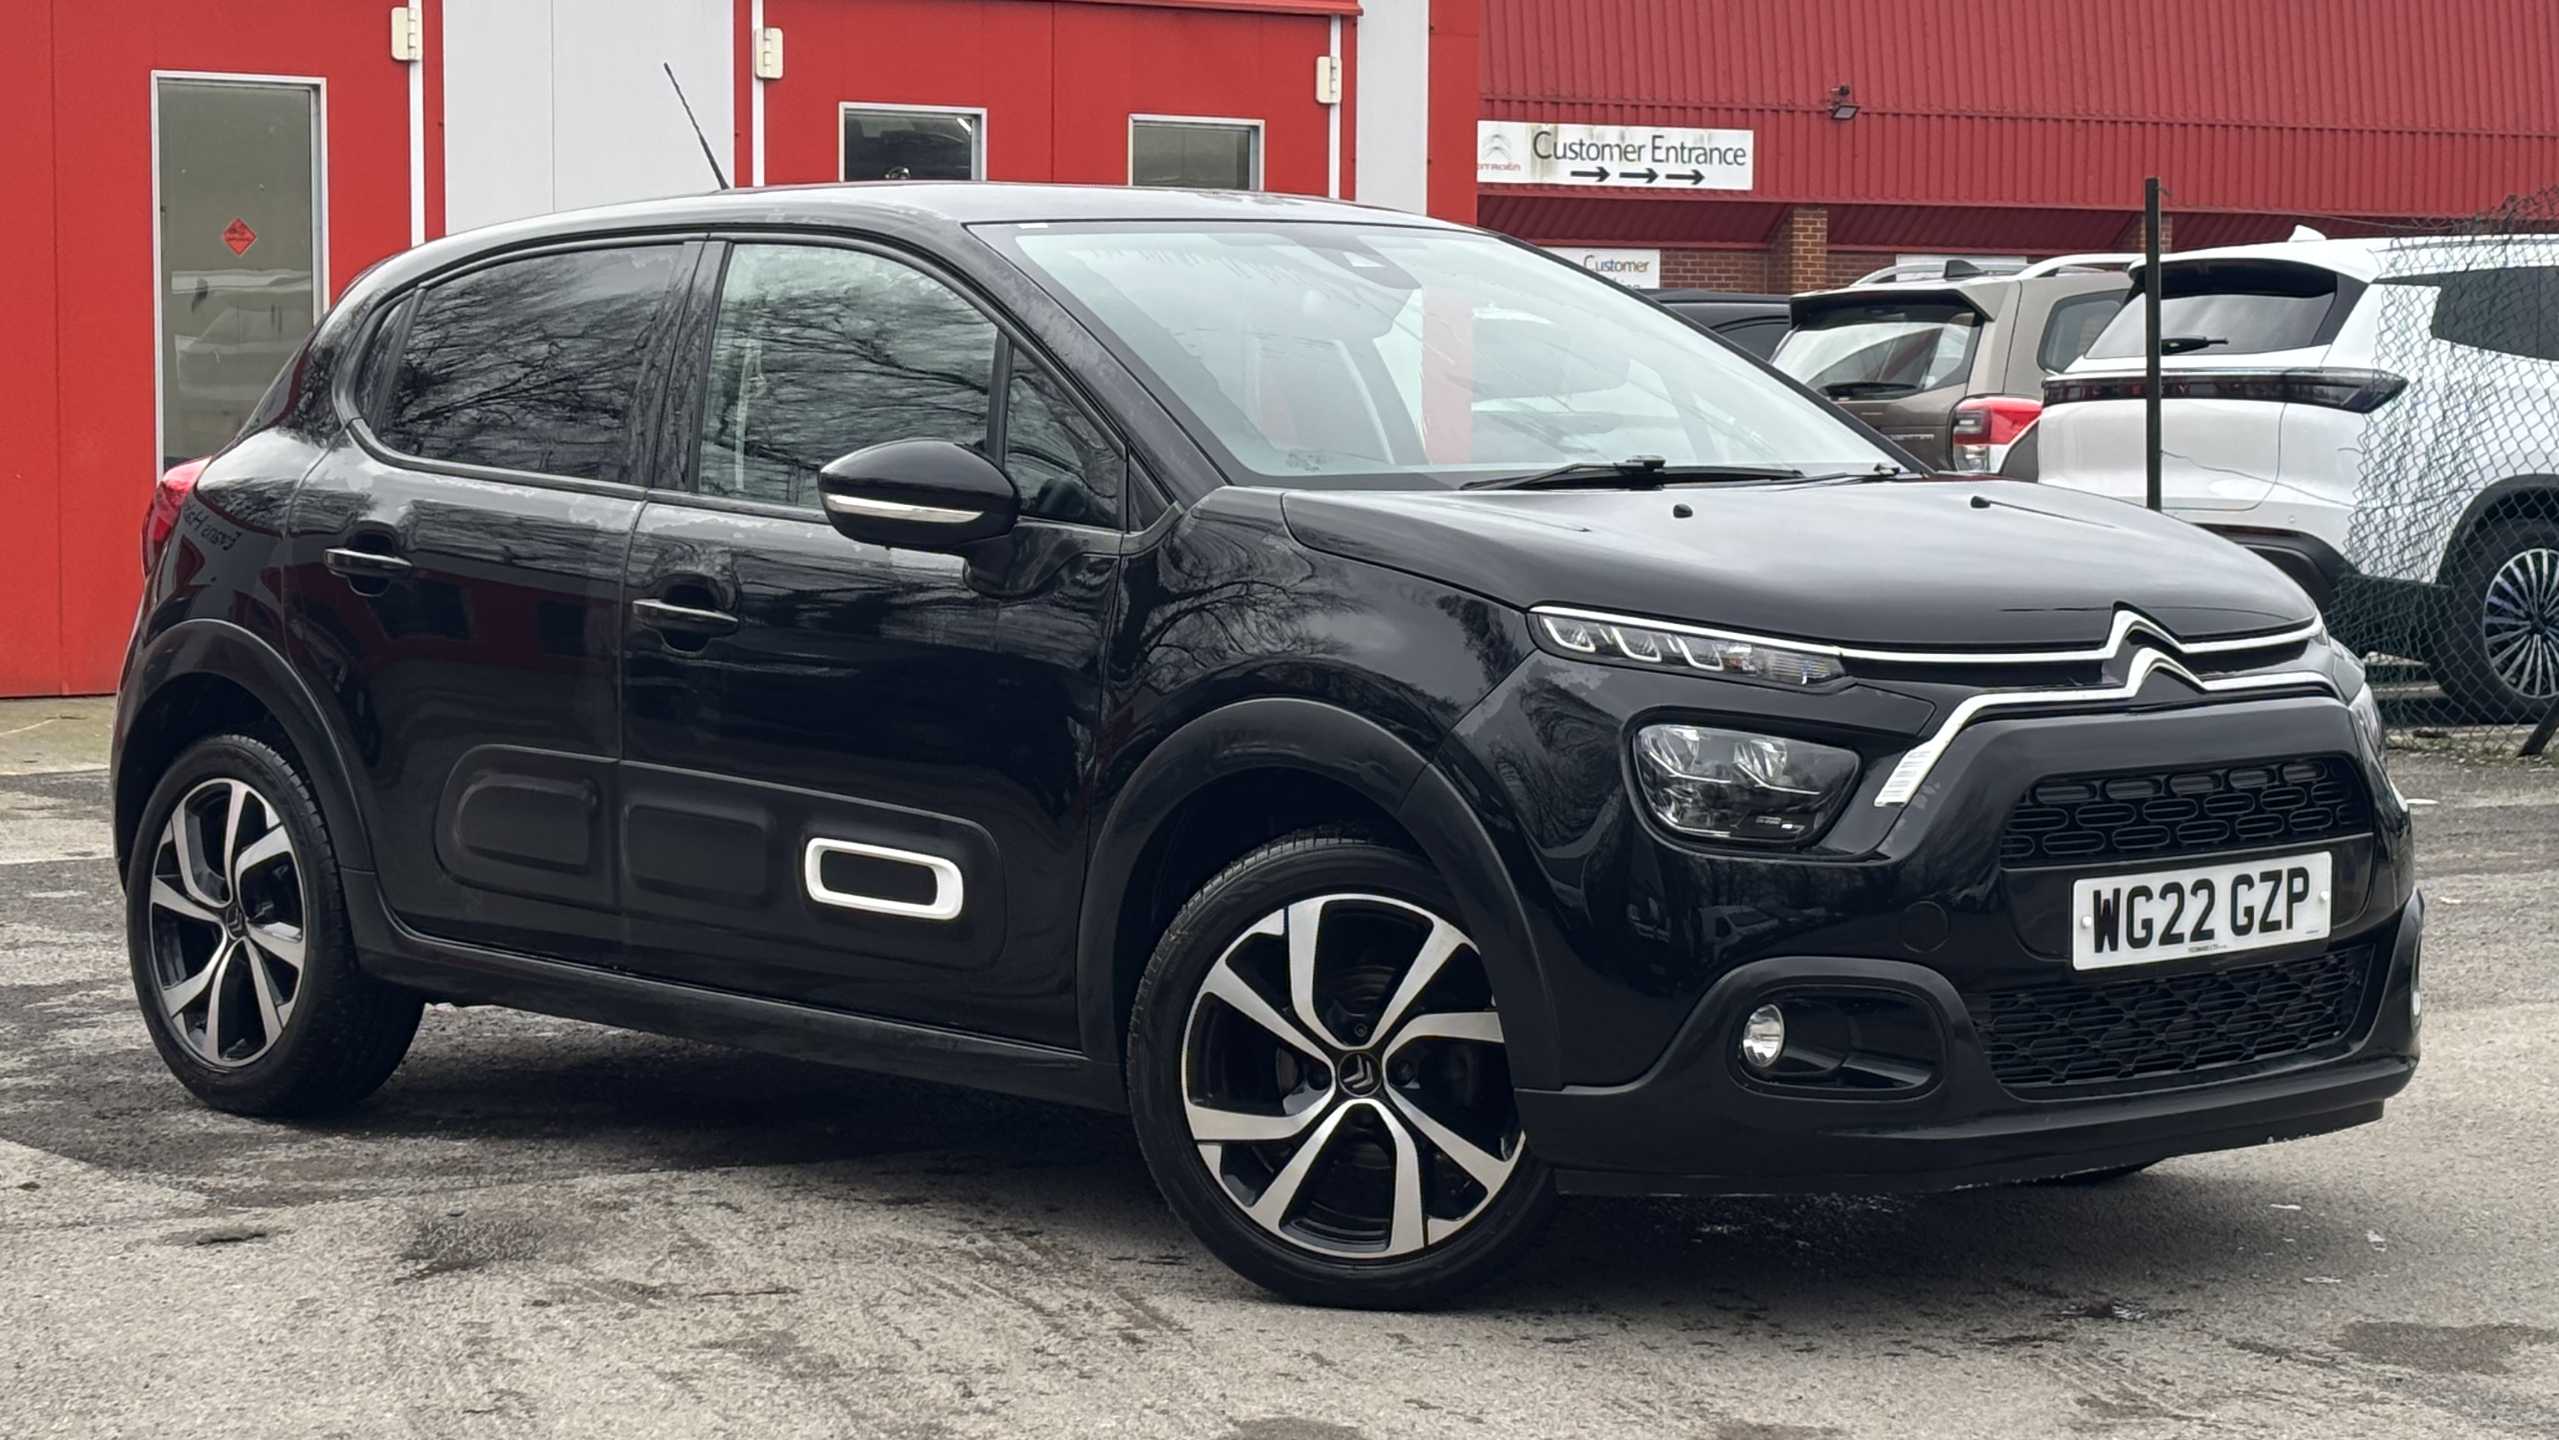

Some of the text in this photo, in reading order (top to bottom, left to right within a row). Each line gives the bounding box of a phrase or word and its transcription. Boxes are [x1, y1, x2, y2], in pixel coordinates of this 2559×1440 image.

[1533, 131, 1746, 166] Customer Entrance
[1584, 255, 1650, 272] Customer
[2093, 866, 2310, 953] WG22 GZP
